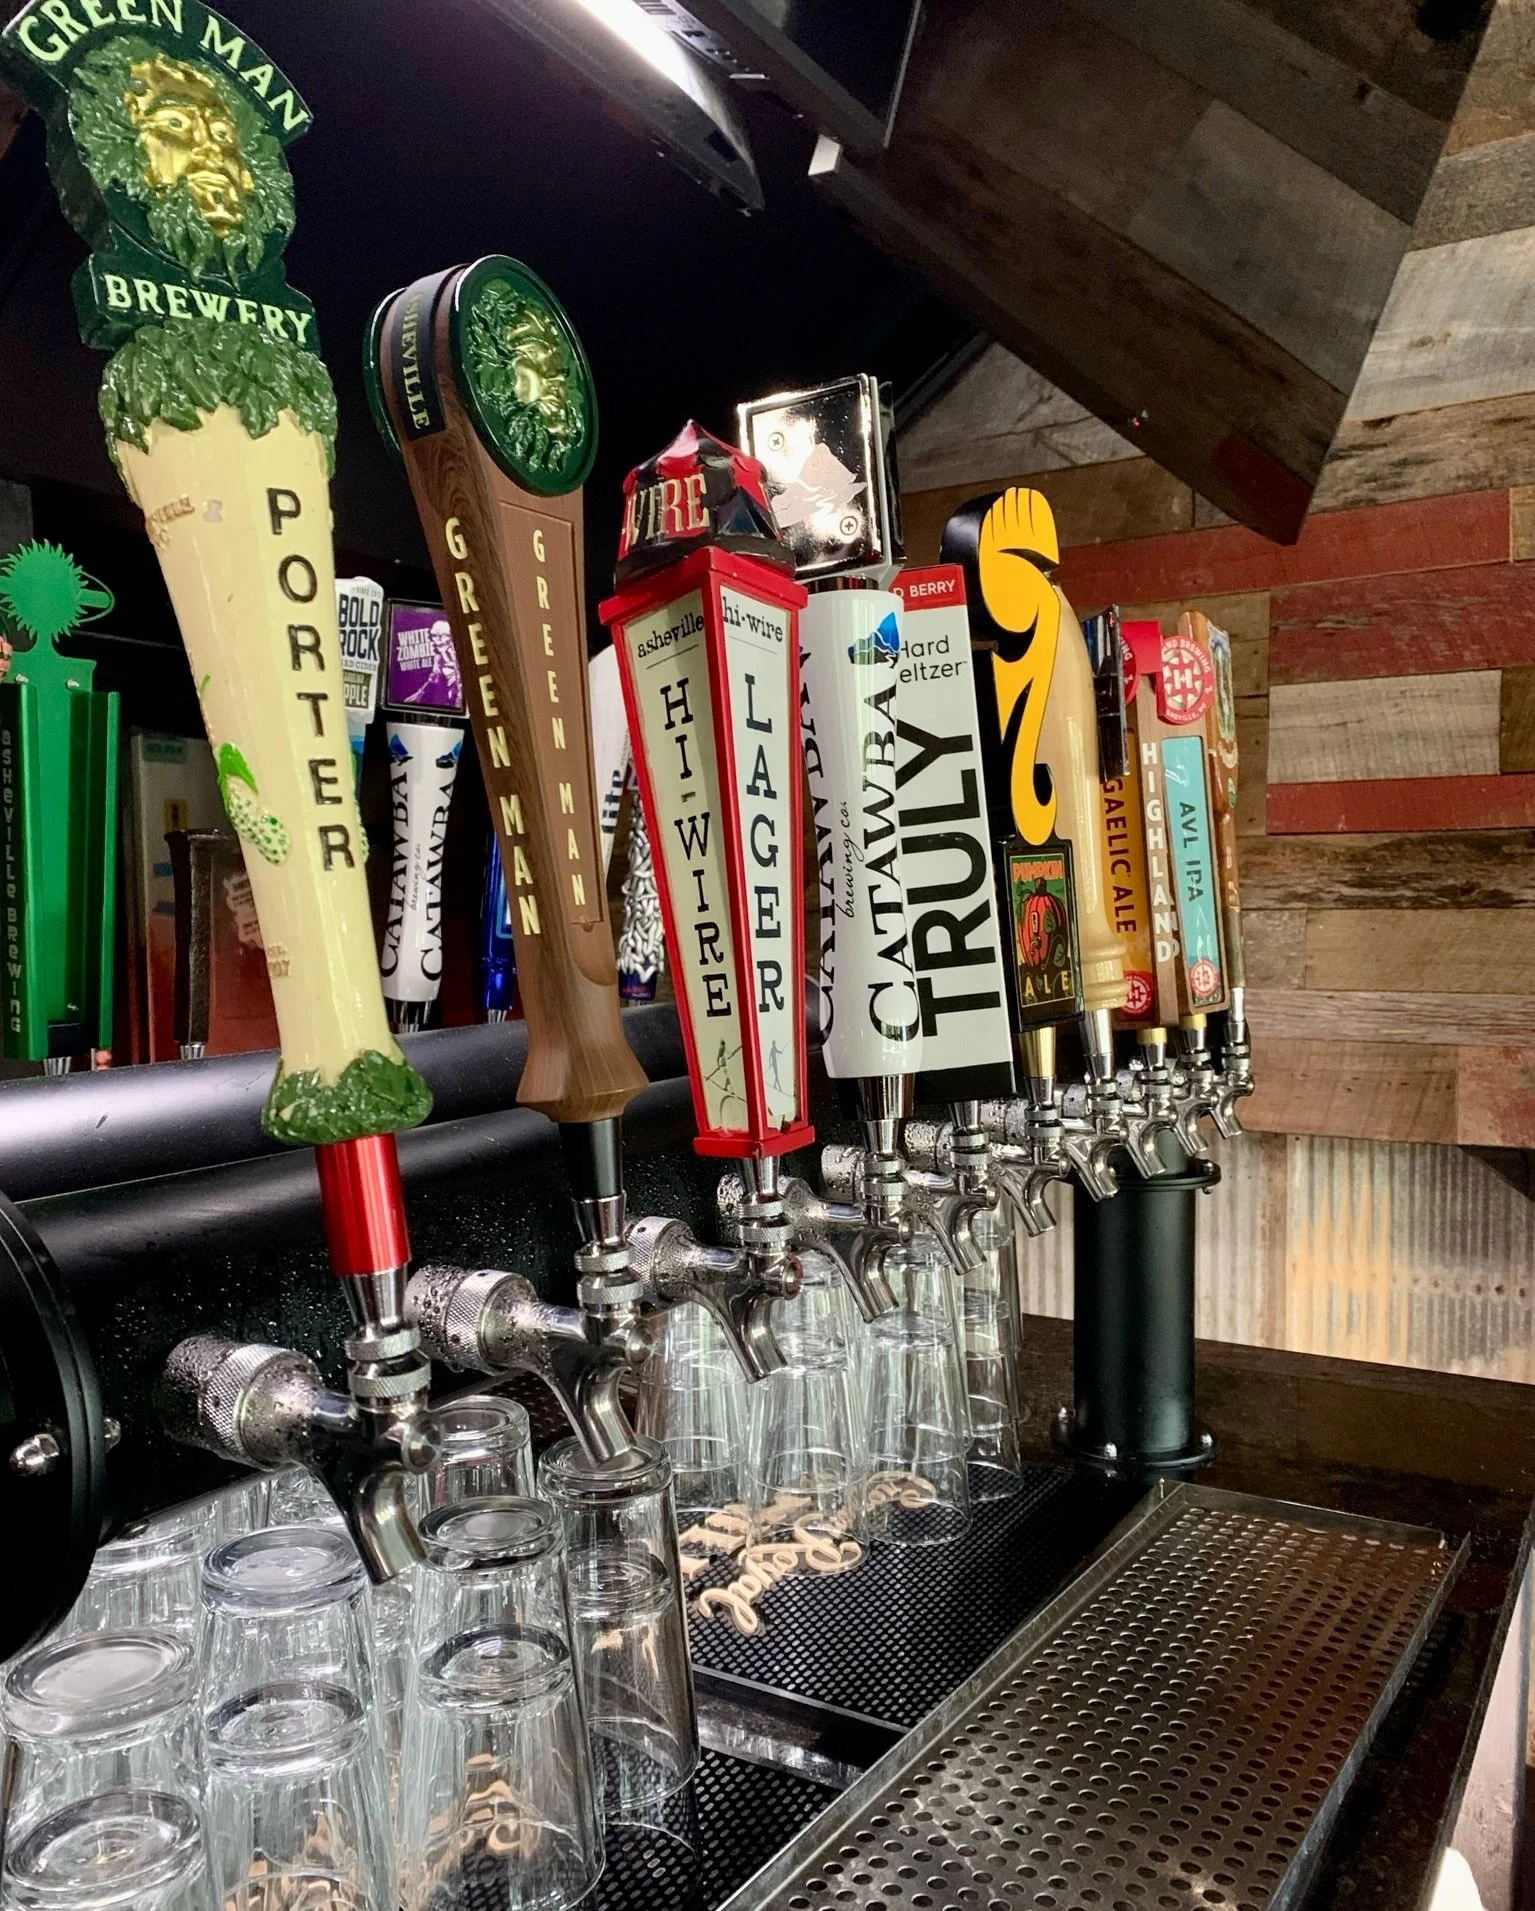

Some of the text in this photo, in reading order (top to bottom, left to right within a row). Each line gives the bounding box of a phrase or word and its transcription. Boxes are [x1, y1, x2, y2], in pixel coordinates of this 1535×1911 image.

[18, 0, 309, 132] GREEN MAN
[104, 274, 312, 343] BREWERY
[402, 292, 431, 430] ASHEVILLE
[339, 593, 380, 628] BOLD
[638, 613, 705, 659] asheville
[722, 597, 784, 643] hi-wire
[909, 580, 956, 598] BERRY
[266, 487, 355, 871] PORTER
[339, 628, 380, 661] ROCK
[396, 642, 435, 662] ZOMBIE
[397, 628, 430, 647] WHITE
[899, 661, 962, 684] eltzer
[900, 634, 950, 659] Hard
[343, 681, 369, 706] PPLE
[445, 516, 541, 936] GREEN MAN
[533, 529, 586, 906] GREEN MAN
[380, 771, 409, 978] CATAWBA
[420, 780, 455, 982] CATAWBA
[660, 677, 732, 1018] HI-WIRE
[745, 673, 785, 1013] LAGER
[835, 831, 865, 918] brewing
[862, 683, 921, 1042] CATAWBA
[895, 718, 1002, 1038] TRULY
[1012, 861, 1064, 882] PUMPKIN
[1104, 776, 1137, 934] GAELIC ALE
[1141, 742, 1172, 963] HIGHLAND
[1180, 801, 1204, 902] AVL IPA
[1025, 970, 1070, 997] ALE
